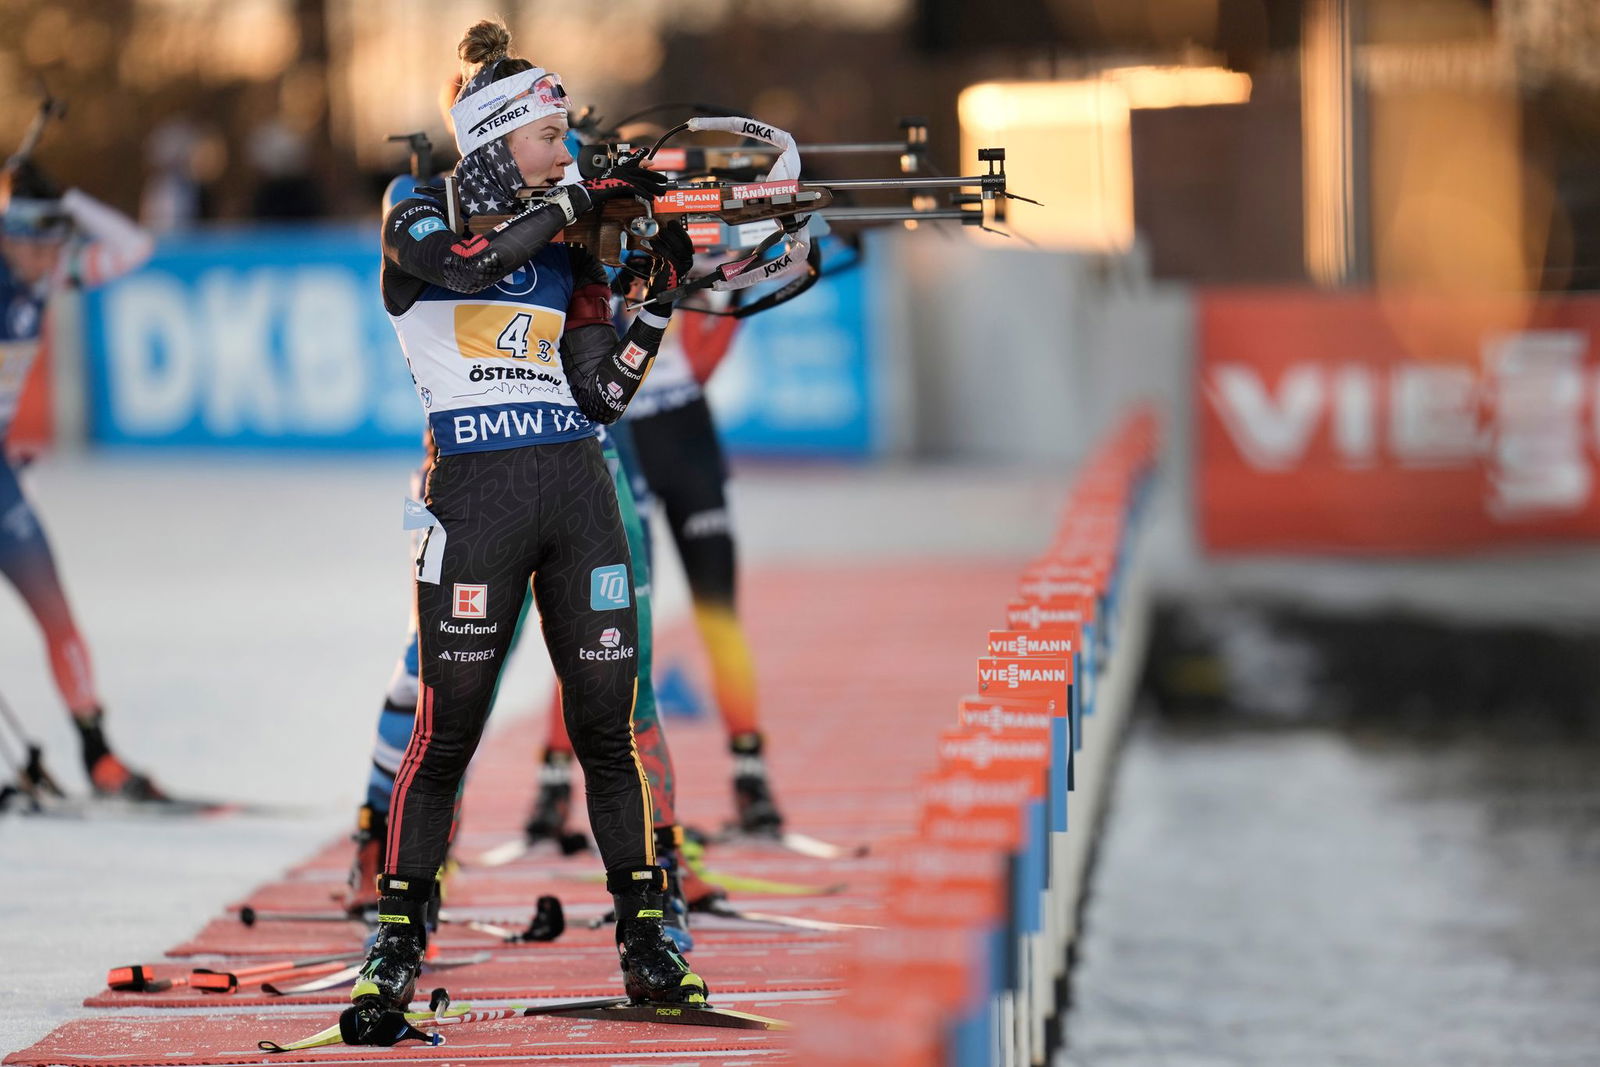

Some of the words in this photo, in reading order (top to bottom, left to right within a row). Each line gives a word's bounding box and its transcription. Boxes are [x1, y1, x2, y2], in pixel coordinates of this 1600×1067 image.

[487, 104, 530, 130] TERREX
[741, 122, 774, 140] JOKA
[655, 192, 719, 207] VIESSMANN
[733, 185, 797, 199] HANDWERK
[401, 205, 444, 219] TERRE
[763, 254, 793, 278] JOKA
[496, 312, 533, 359] 4
[536, 339, 552, 363] 3
[105, 267, 365, 435] DKB
[612, 352, 643, 381] Kaufland
[453, 409, 544, 444] BMW
[440, 620, 498, 635] Kaufland
[453, 648, 495, 662] TERREX
[579, 645, 634, 661] tectake
[991, 636, 1071, 656] VIESSMANN
[980, 664, 1065, 688] VIESSMANN
